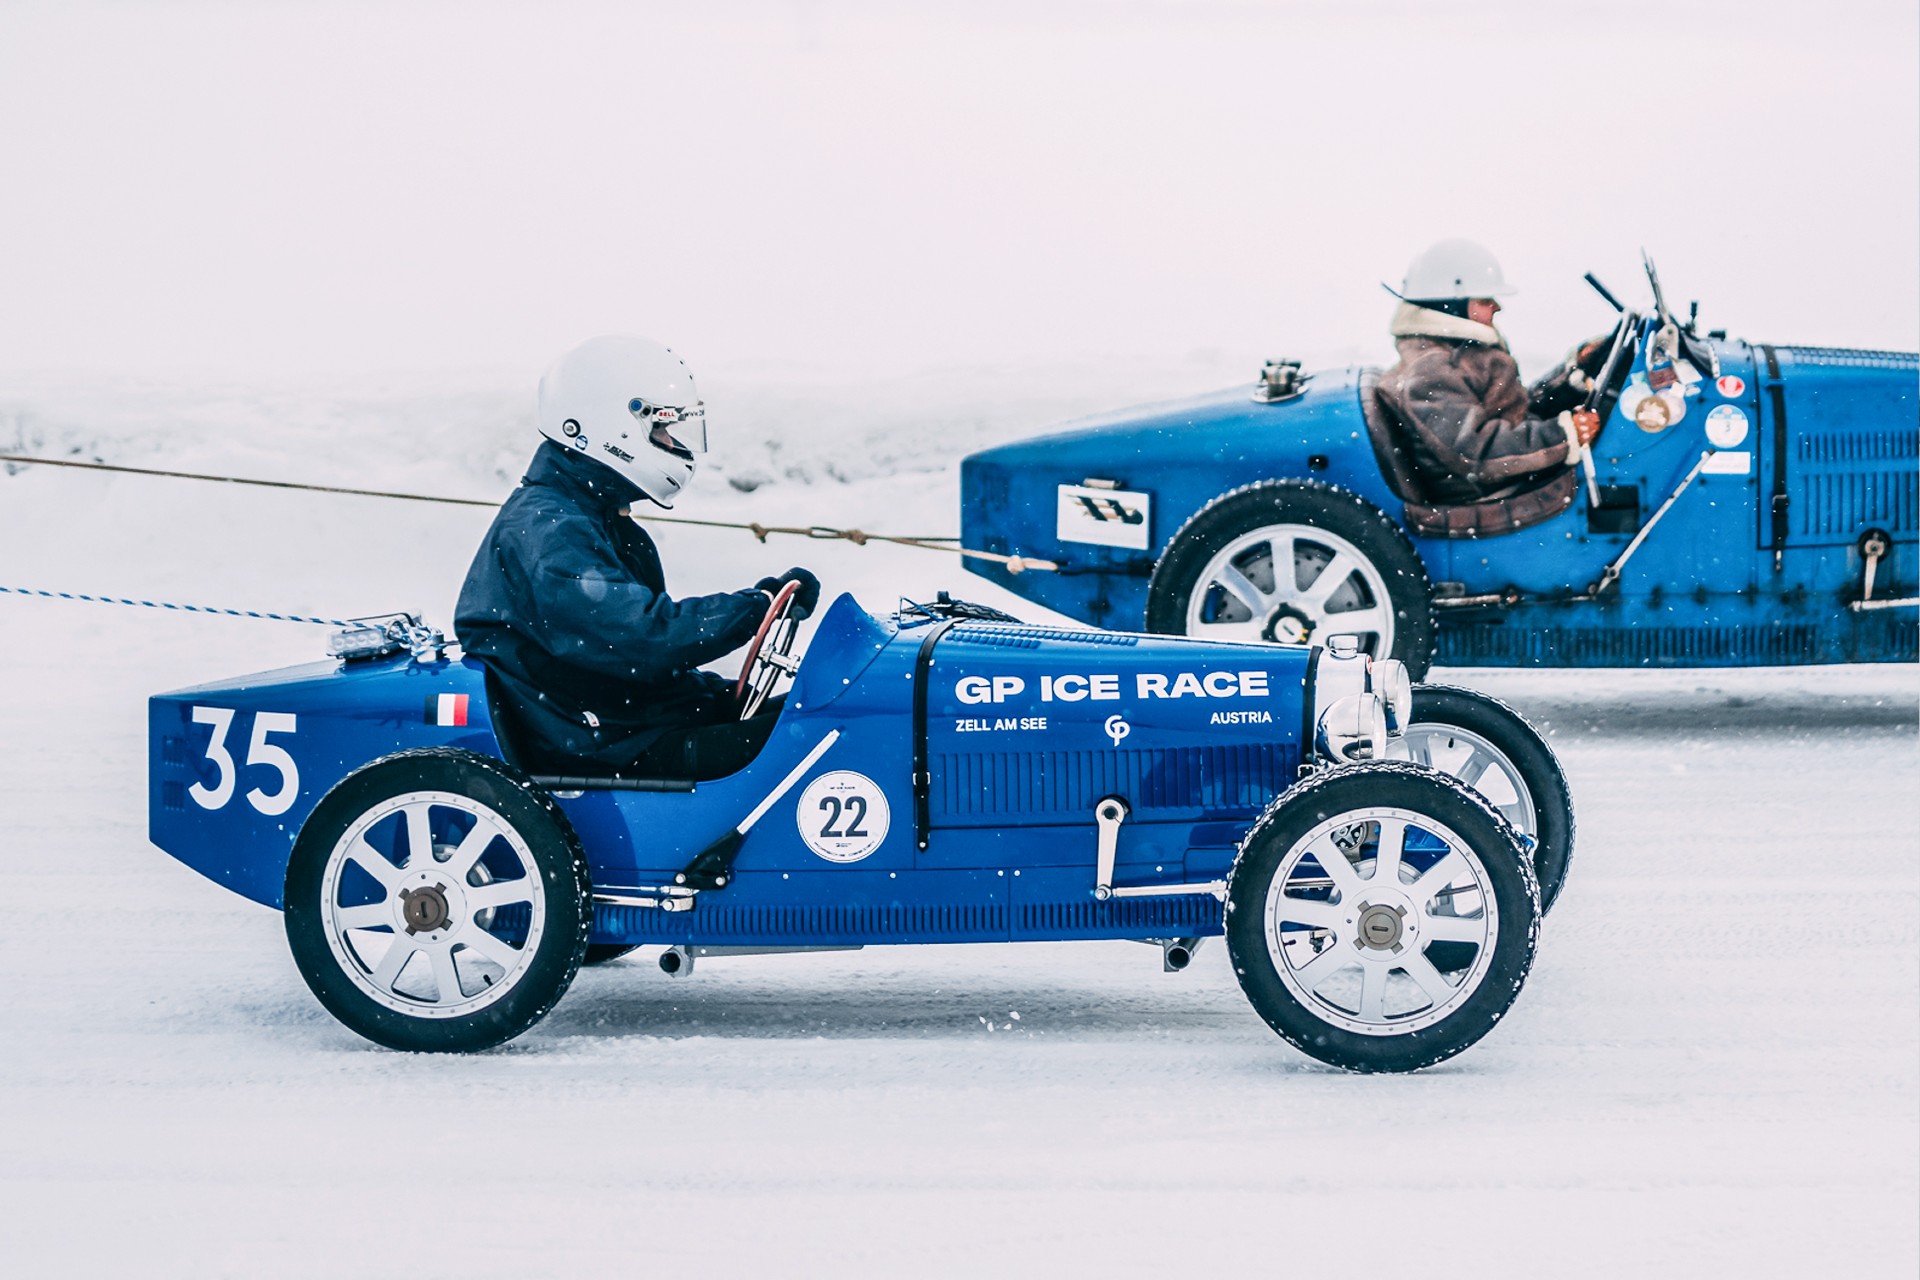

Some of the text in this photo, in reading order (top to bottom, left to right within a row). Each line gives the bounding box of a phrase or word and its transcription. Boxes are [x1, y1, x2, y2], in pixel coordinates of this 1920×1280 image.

[954, 671, 1270, 705] GP ICE RACE
[955, 717, 1047, 732] ZELL AM SEE
[1210, 710, 1273, 725] AUSTRIA
[188, 705, 300, 816] 35
[819, 795, 868, 838] 22
